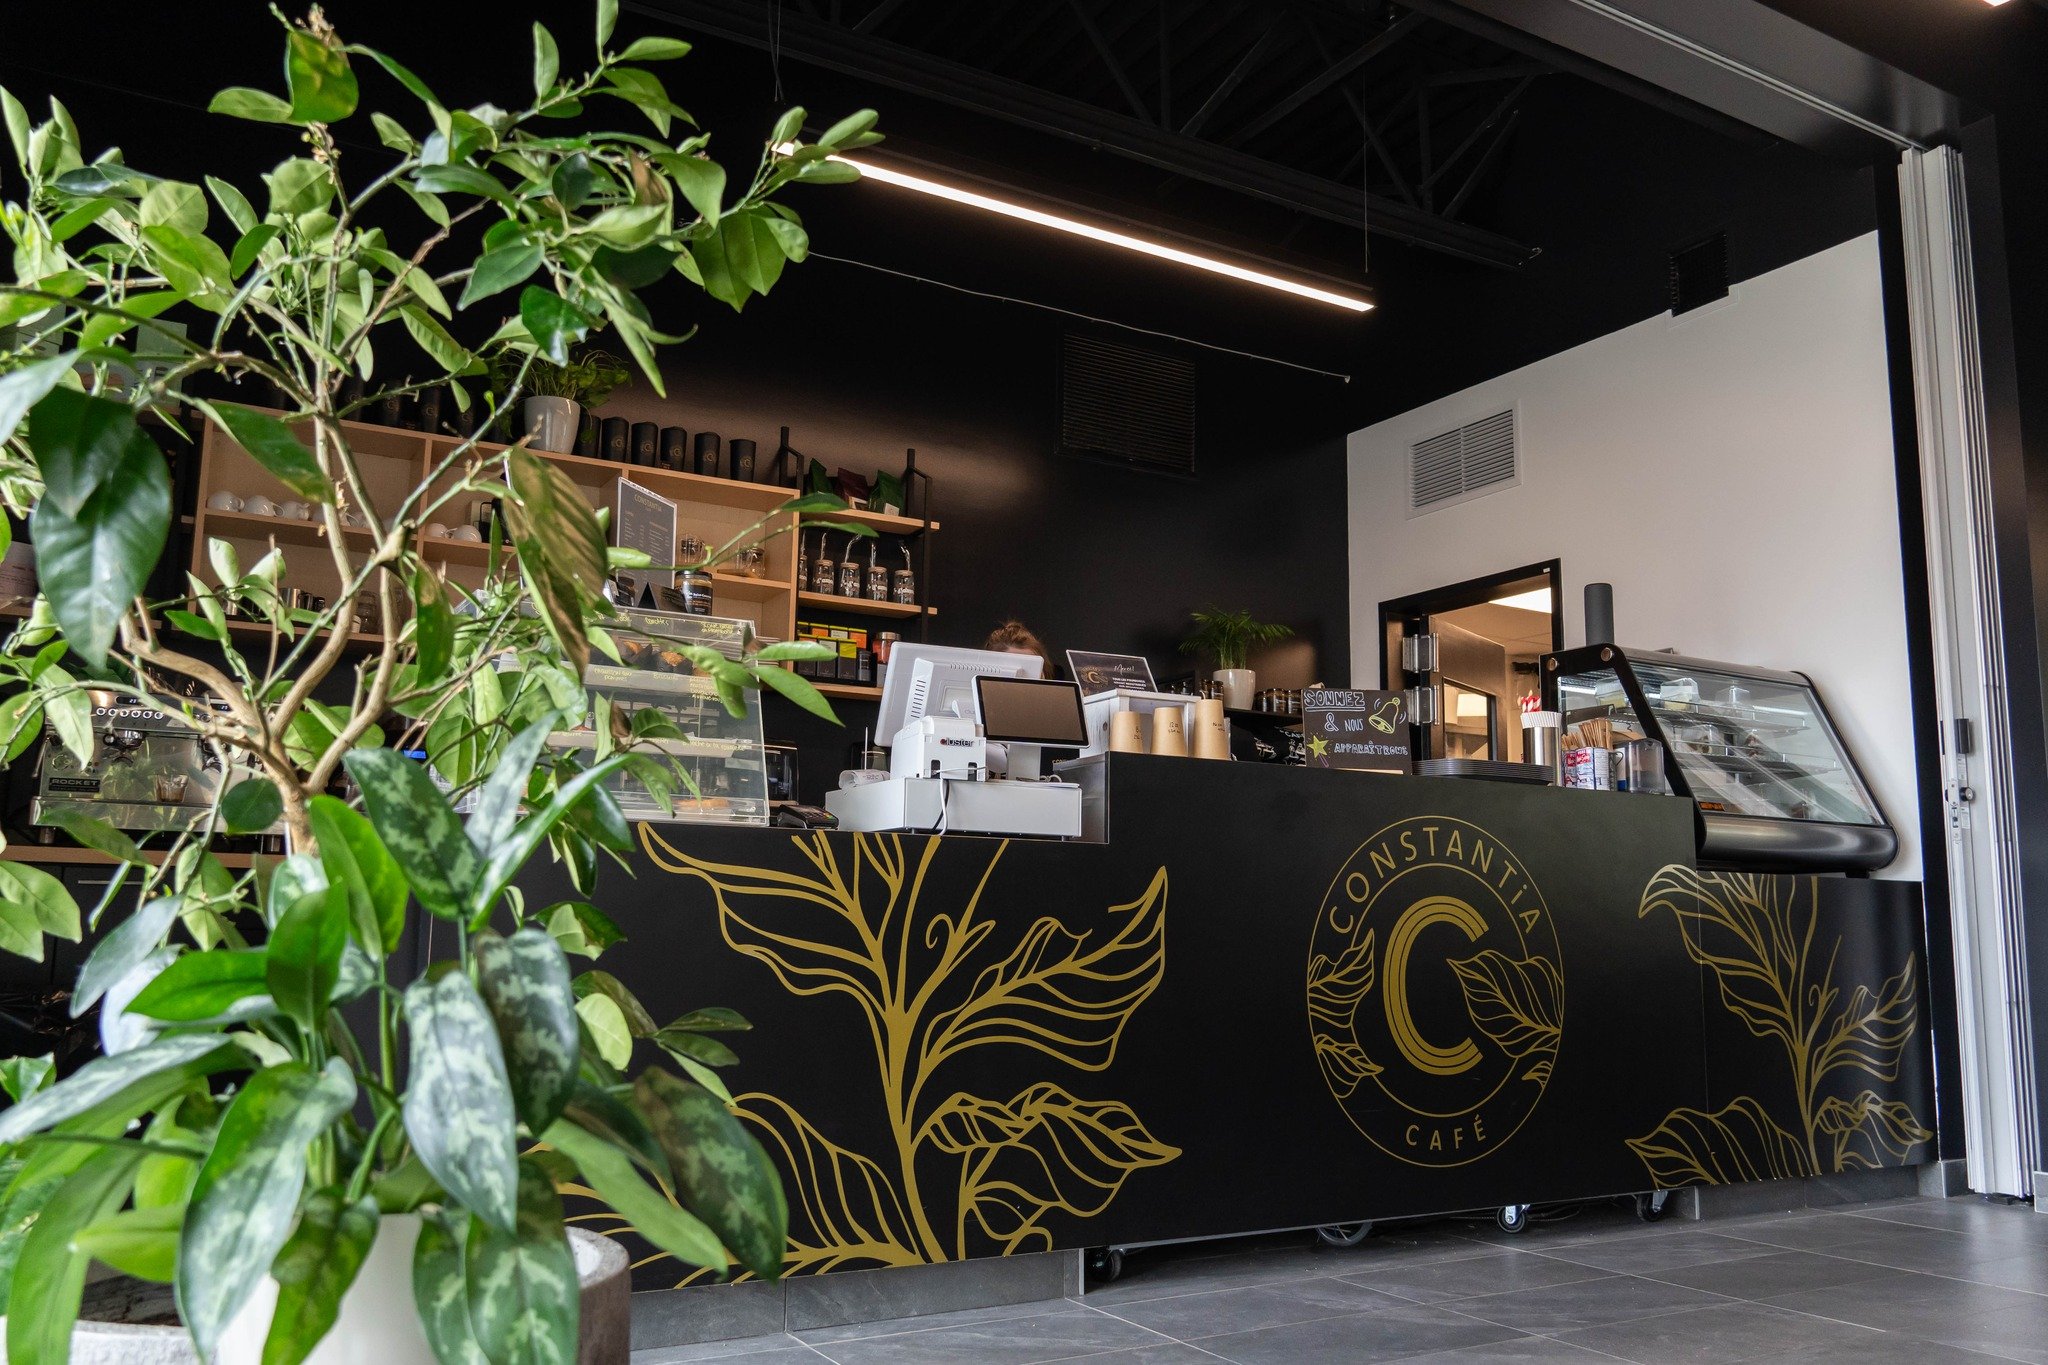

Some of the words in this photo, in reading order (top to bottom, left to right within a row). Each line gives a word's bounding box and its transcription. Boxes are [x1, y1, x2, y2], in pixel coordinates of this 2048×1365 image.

[1304, 690, 1366, 707] SONNEZ
[1324, 712, 1339, 732] &
[1344, 719, 1364, 732] NOUS
[51, 778, 98, 786] ROCKET
[1405, 1115, 1487, 1151] CAFÉ
